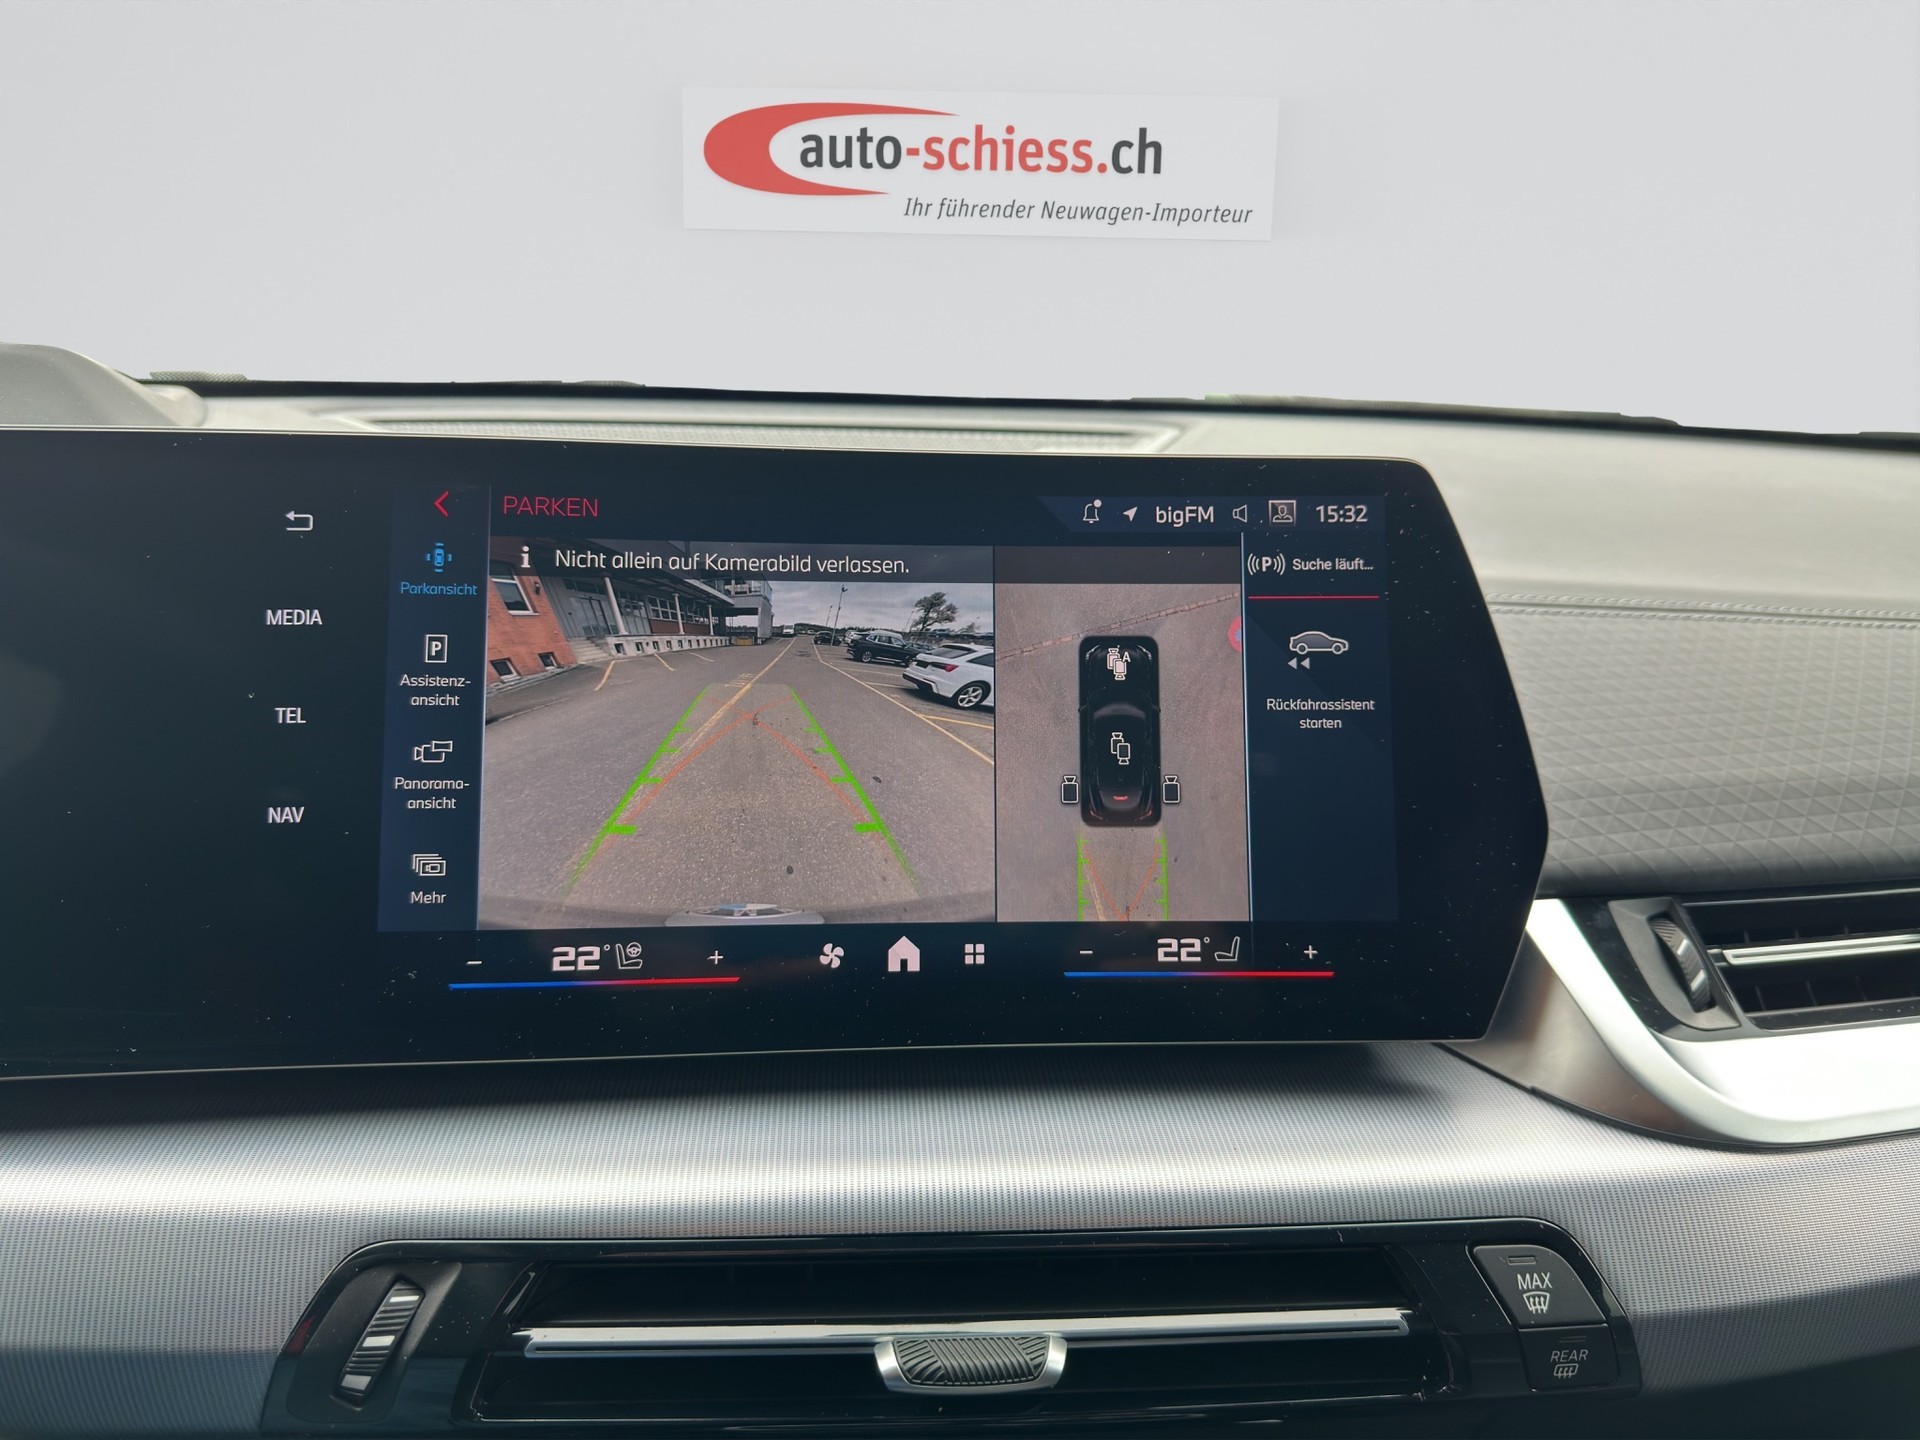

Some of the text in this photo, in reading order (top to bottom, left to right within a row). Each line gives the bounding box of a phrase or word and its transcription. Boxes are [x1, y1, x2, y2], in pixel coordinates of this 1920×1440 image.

[800, 124, 1163, 175] auto-schiess.ch
[904, 197, 1254, 227] Ihr führender Neuwagen-Importeur
[503, 496, 599, 517] PARKEN
[1315, 505, 1368, 523] 15:32
[1155, 505, 1215, 527] bigFM
[555, 550, 910, 575] Nicht allein auf Kamerabild verlassen.
[1292, 557, 1375, 572] Suche läuft...
[400, 581, 478, 596] Parkansicht
[266, 608, 323, 626] MEDIA
[430, 641, 442, 656] P
[400, 674, 472, 688] Assistenz-
[410, 693, 460, 707] ansicht
[1266, 698, 1375, 712] Rückfahrassistent
[275, 707, 307, 724] TEL
[1299, 718, 1342, 730] starten
[394, 776, 471, 791] Panorama-
[407, 796, 457, 810] ansicht
[267, 806, 304, 824] NAV
[410, 890, 447, 904] Mehr
[1517, 1272, 1553, 1290] MAX
[1550, 1349, 1589, 1363] REAR
